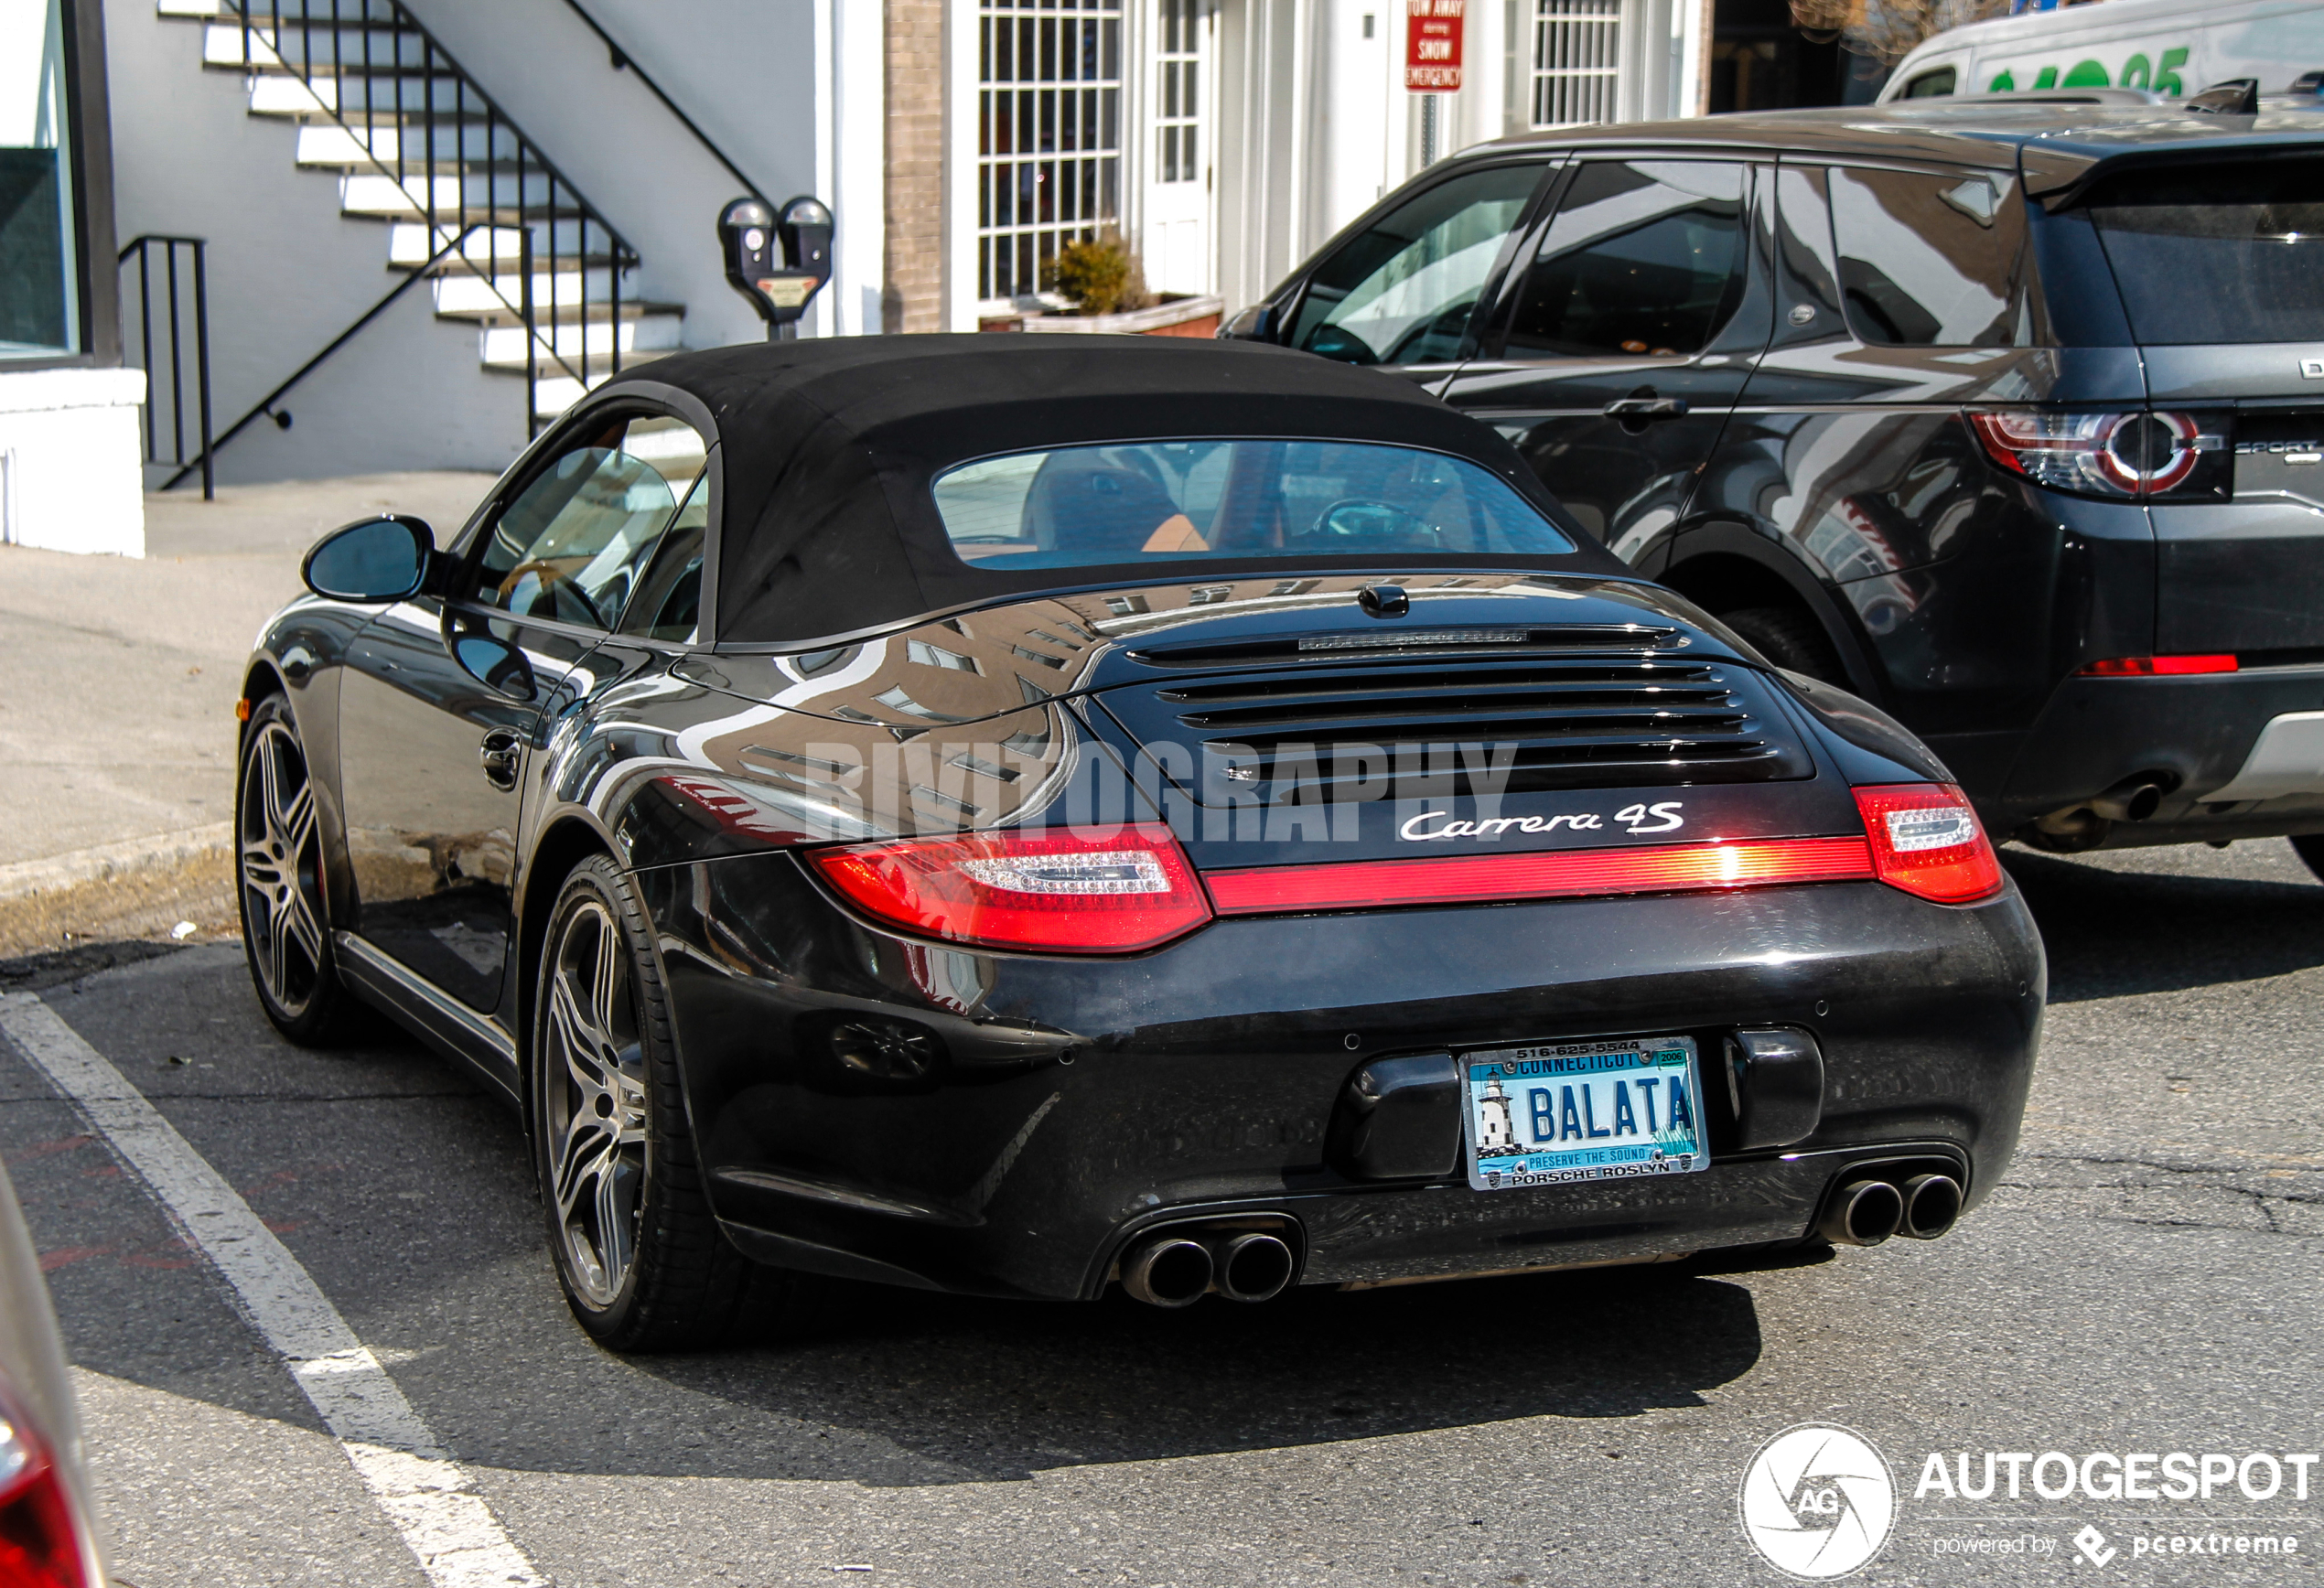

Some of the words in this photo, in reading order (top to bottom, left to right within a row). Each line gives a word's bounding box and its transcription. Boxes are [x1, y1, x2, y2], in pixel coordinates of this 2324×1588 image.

[1417, 39, 1452, 59] SNOW
[1406, 68, 1460, 86] EMERGENCY
[2234, 440, 2318, 454] SPORT
[1400, 810, 1603, 842] Carrera
[1613, 801, 1684, 834] 4S
[1516, 1041, 1640, 1059] 516-625-5544
[1661, 1052, 1683, 1062] 2006
[1529, 1075, 1691, 1143] BALATA
[1529, 1153, 1580, 1169] PRESERVE
[1585, 1152, 1605, 1164] THE
[1610, 1148, 1645, 1162] SOUND
[1512, 1169, 1597, 1186] PORSCHE
[1602, 1164, 1670, 1177] ROSLYN
